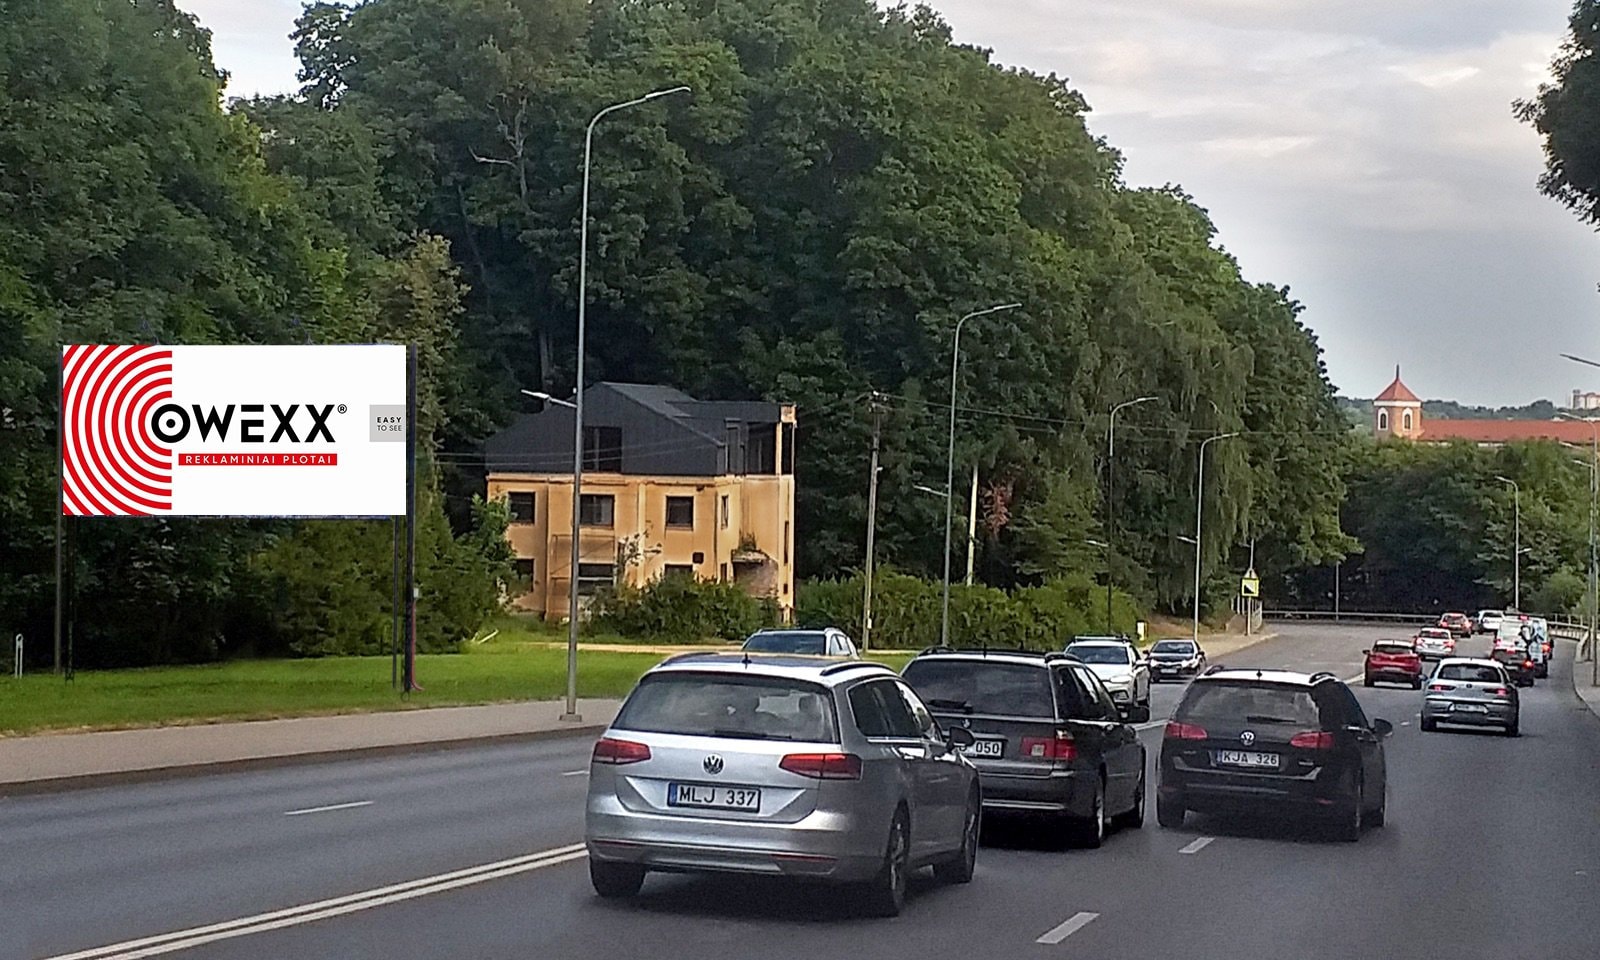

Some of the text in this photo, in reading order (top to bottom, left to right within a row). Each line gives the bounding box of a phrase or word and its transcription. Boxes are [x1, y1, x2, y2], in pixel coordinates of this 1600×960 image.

[376, 416, 402, 424] EASY
[185, 455, 331, 464] REKLAMINIAI PLOTAI
[975, 741, 1000, 754] 050
[1222, 751, 1278, 765] KJA 326
[679, 785, 716, 803] MLJ
[726, 789, 756, 806] 337
